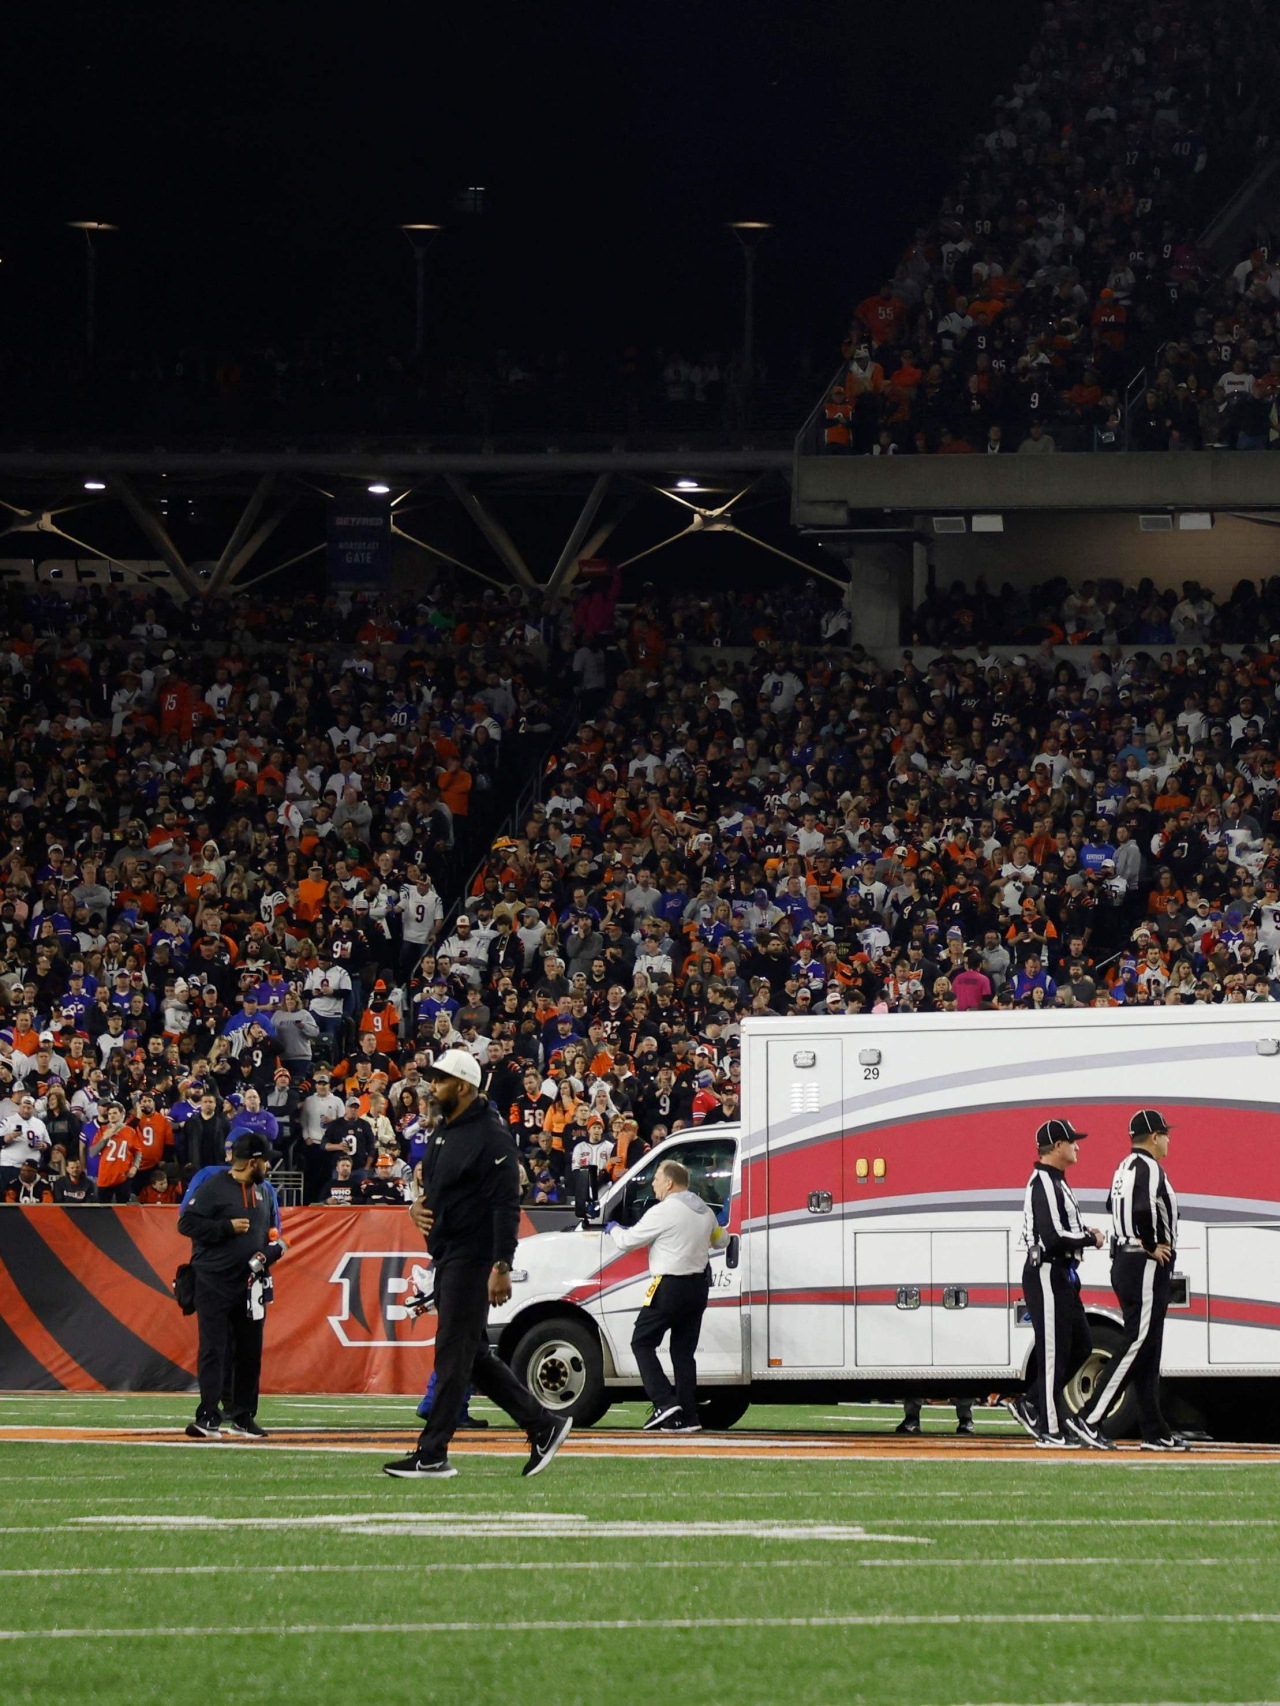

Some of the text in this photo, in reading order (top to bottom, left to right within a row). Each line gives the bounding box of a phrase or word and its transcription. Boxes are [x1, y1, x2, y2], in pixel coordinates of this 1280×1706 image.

[1126, 151, 1139, 165] 17
[1162, 245, 1172, 259] 9
[878, 306, 893, 320] 55
[977, 336, 986, 348] 9
[1030, 392, 1040, 408] 9
[336, 517, 383, 526] BETFRED
[339, 542, 380, 550] NORTHEAST
[345, 552, 373, 564] GATE
[23, 684, 31, 699] 9
[164, 694, 176, 710] 15
[391, 712, 407, 726] 40
[519, 717, 526, 732] 2
[988, 776, 995, 792] 9
[414, 850, 422, 864] 9
[1177, 842, 1187, 858] 7
[415, 904, 425, 923] 9
[903, 905, 911, 919] 9
[374, 1016, 382, 1031] 9
[253, 1051, 262, 1067] 9
[864, 1067, 880, 1080] 29
[485, 1072, 493, 1092] 1
[659, 1096, 670, 1115] 9
[524, 1109, 544, 1128] 58
[142, 1127, 153, 1146] 9
[107, 1140, 127, 1161] 24
[346, 1135, 357, 1155] 9
[646, 1284, 656, 1298] 9
